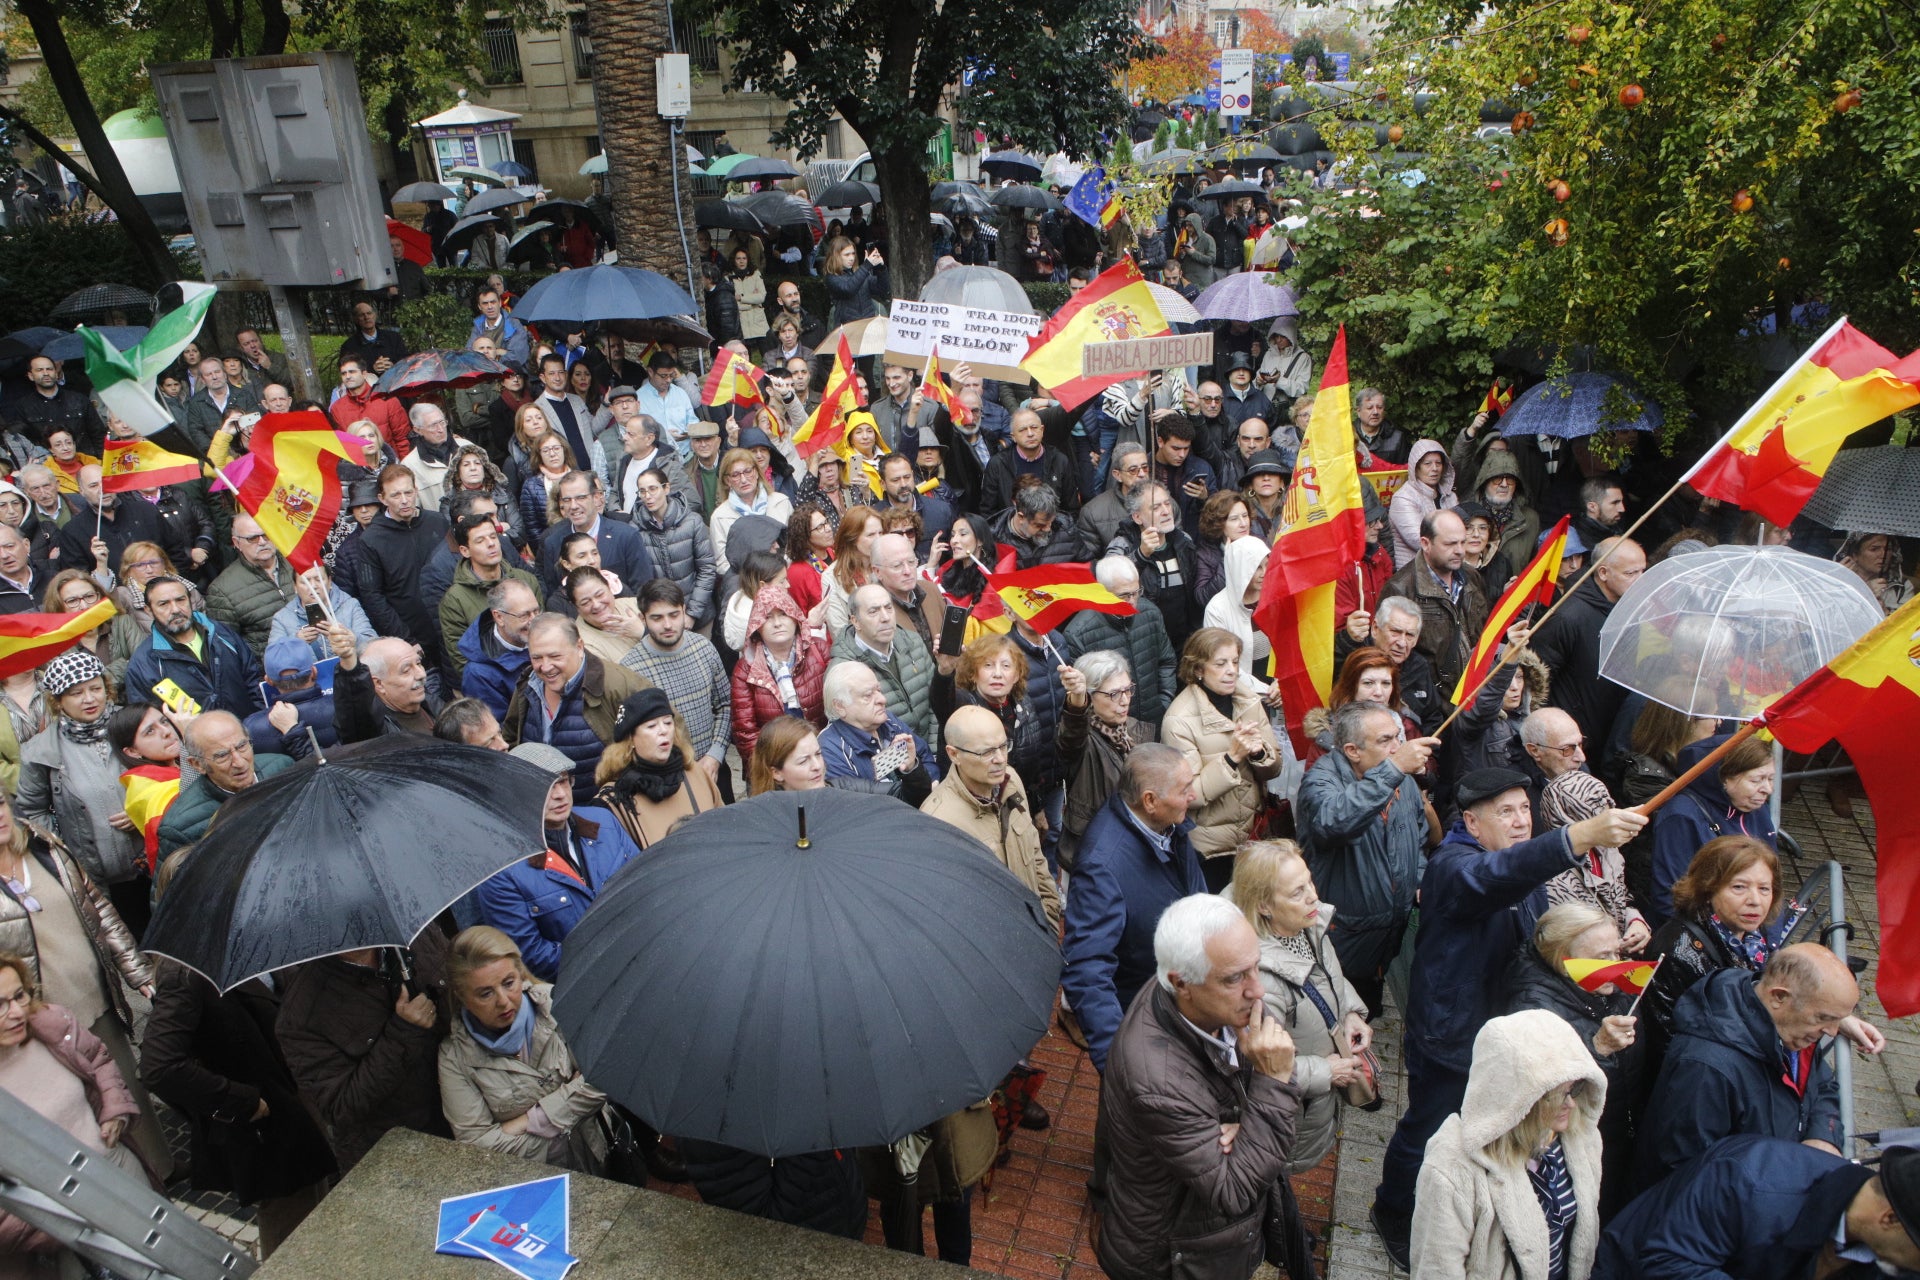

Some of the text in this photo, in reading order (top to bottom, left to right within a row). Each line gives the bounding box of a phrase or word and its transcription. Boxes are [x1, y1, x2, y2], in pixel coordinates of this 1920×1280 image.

[899, 302, 949, 316] PEDRO
[892, 315, 1030, 337] SOLO TE IMPORTA
[898, 329, 921, 340] TU
[1149, 335, 1210, 367] PUEBLO!
